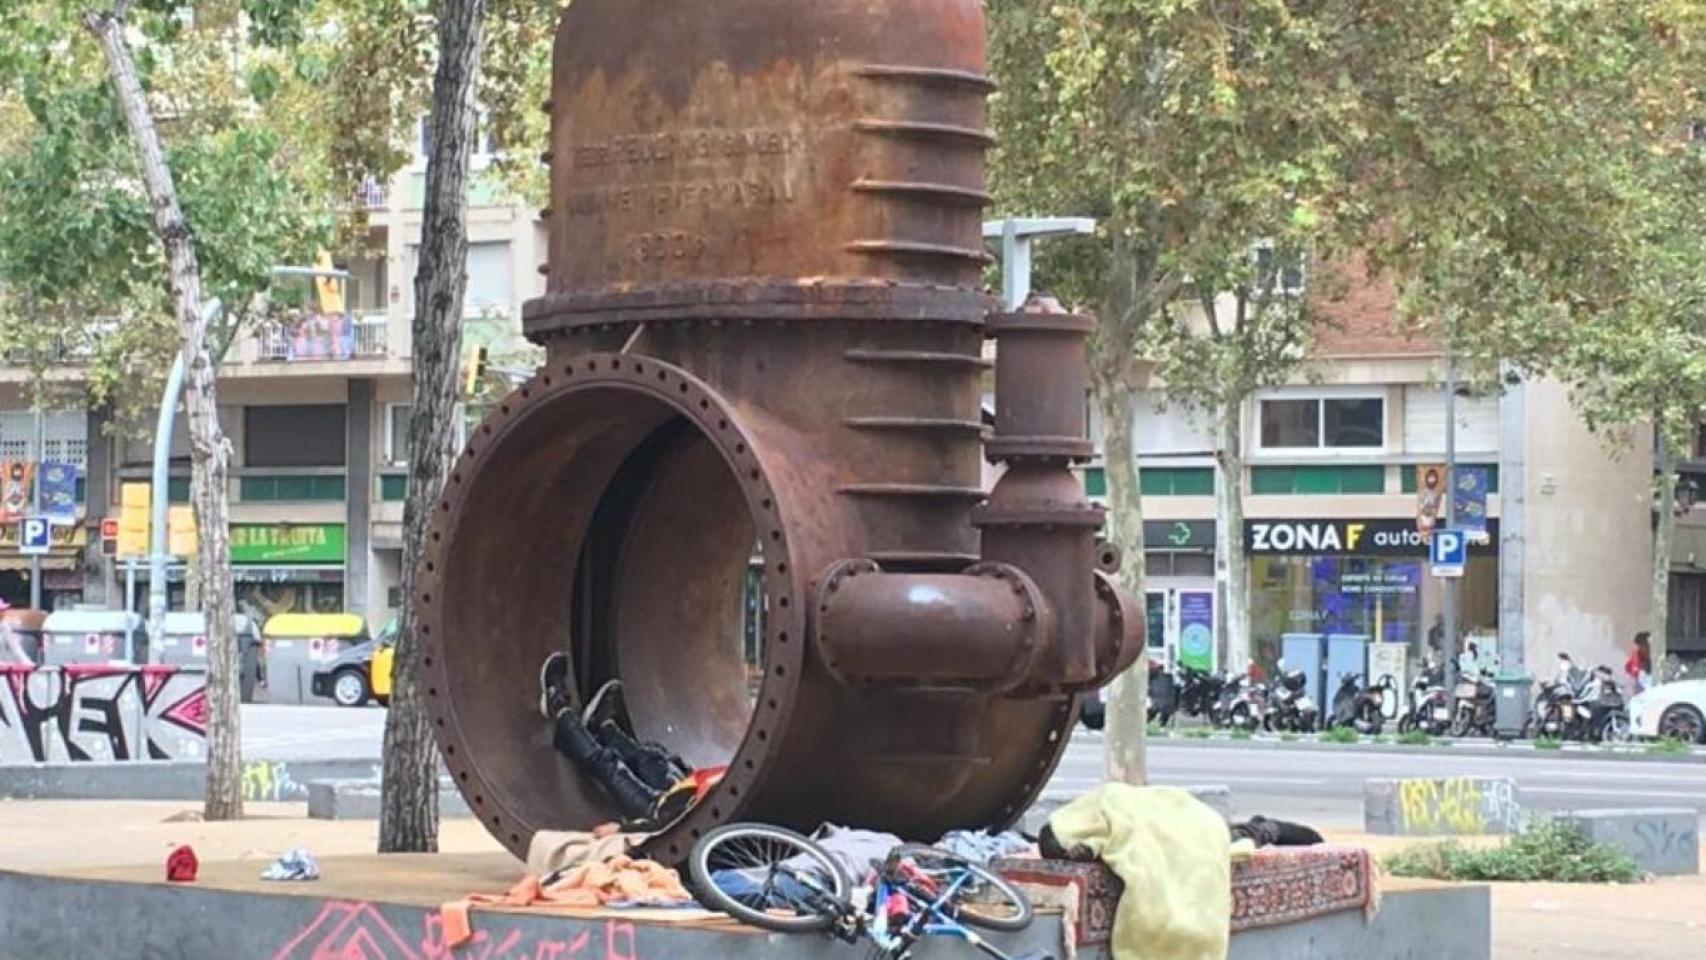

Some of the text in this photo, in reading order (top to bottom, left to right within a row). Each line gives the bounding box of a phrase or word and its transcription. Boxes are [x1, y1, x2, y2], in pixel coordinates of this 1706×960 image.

[25, 520, 45, 546] P
[1251, 523, 1366, 551] ZONA F
[1437, 533, 1458, 561] P
